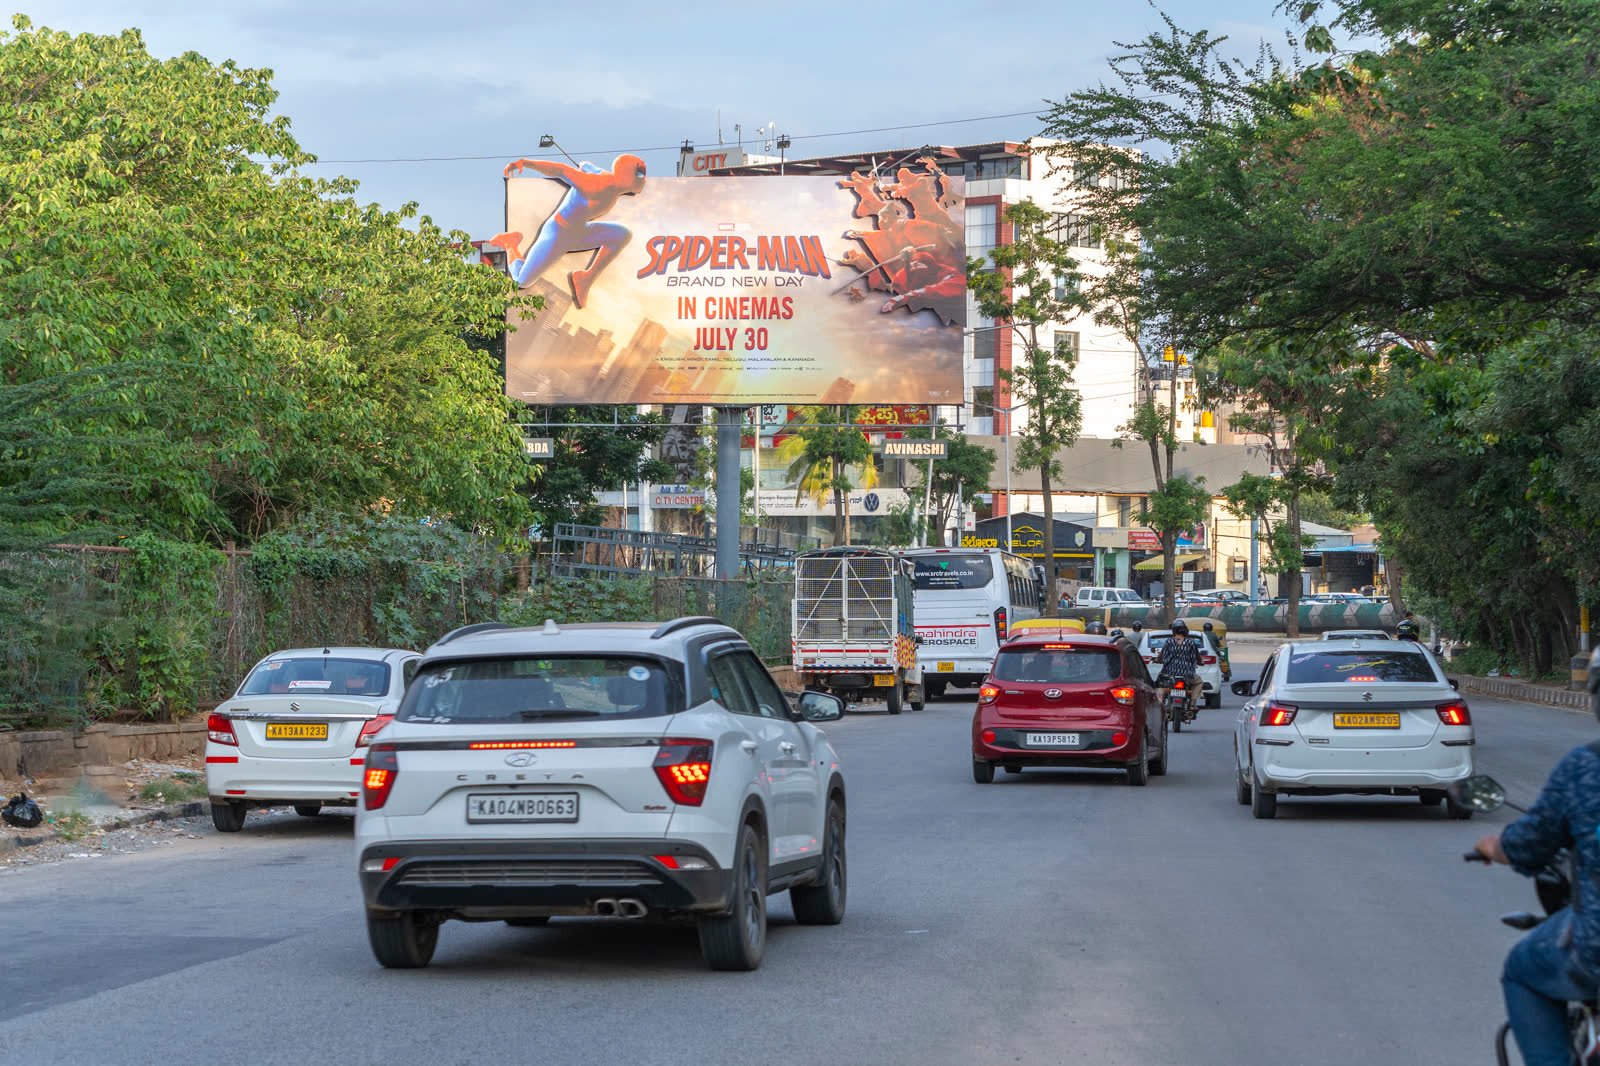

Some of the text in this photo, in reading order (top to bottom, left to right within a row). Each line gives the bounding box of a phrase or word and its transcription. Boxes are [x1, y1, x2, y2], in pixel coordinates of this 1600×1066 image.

[693, 153, 727, 171] CITY
[637, 236, 831, 279] SPIDER-MAN
[667, 276, 804, 287] BRAND NEW DAY
[677, 296, 794, 320] IN CINEMAS
[693, 327, 769, 351] JULY 30
[885, 443, 945, 455] AVINASHI
[675, 495, 705, 505] CENTRE
[914, 629, 977, 638] mahindra
[920, 638, 977, 646] EROSPACE
[271, 726, 326, 737] KA13AA1233
[1032, 735, 1076, 744] KA13P5812
[456, 773, 584, 781] CRETA
